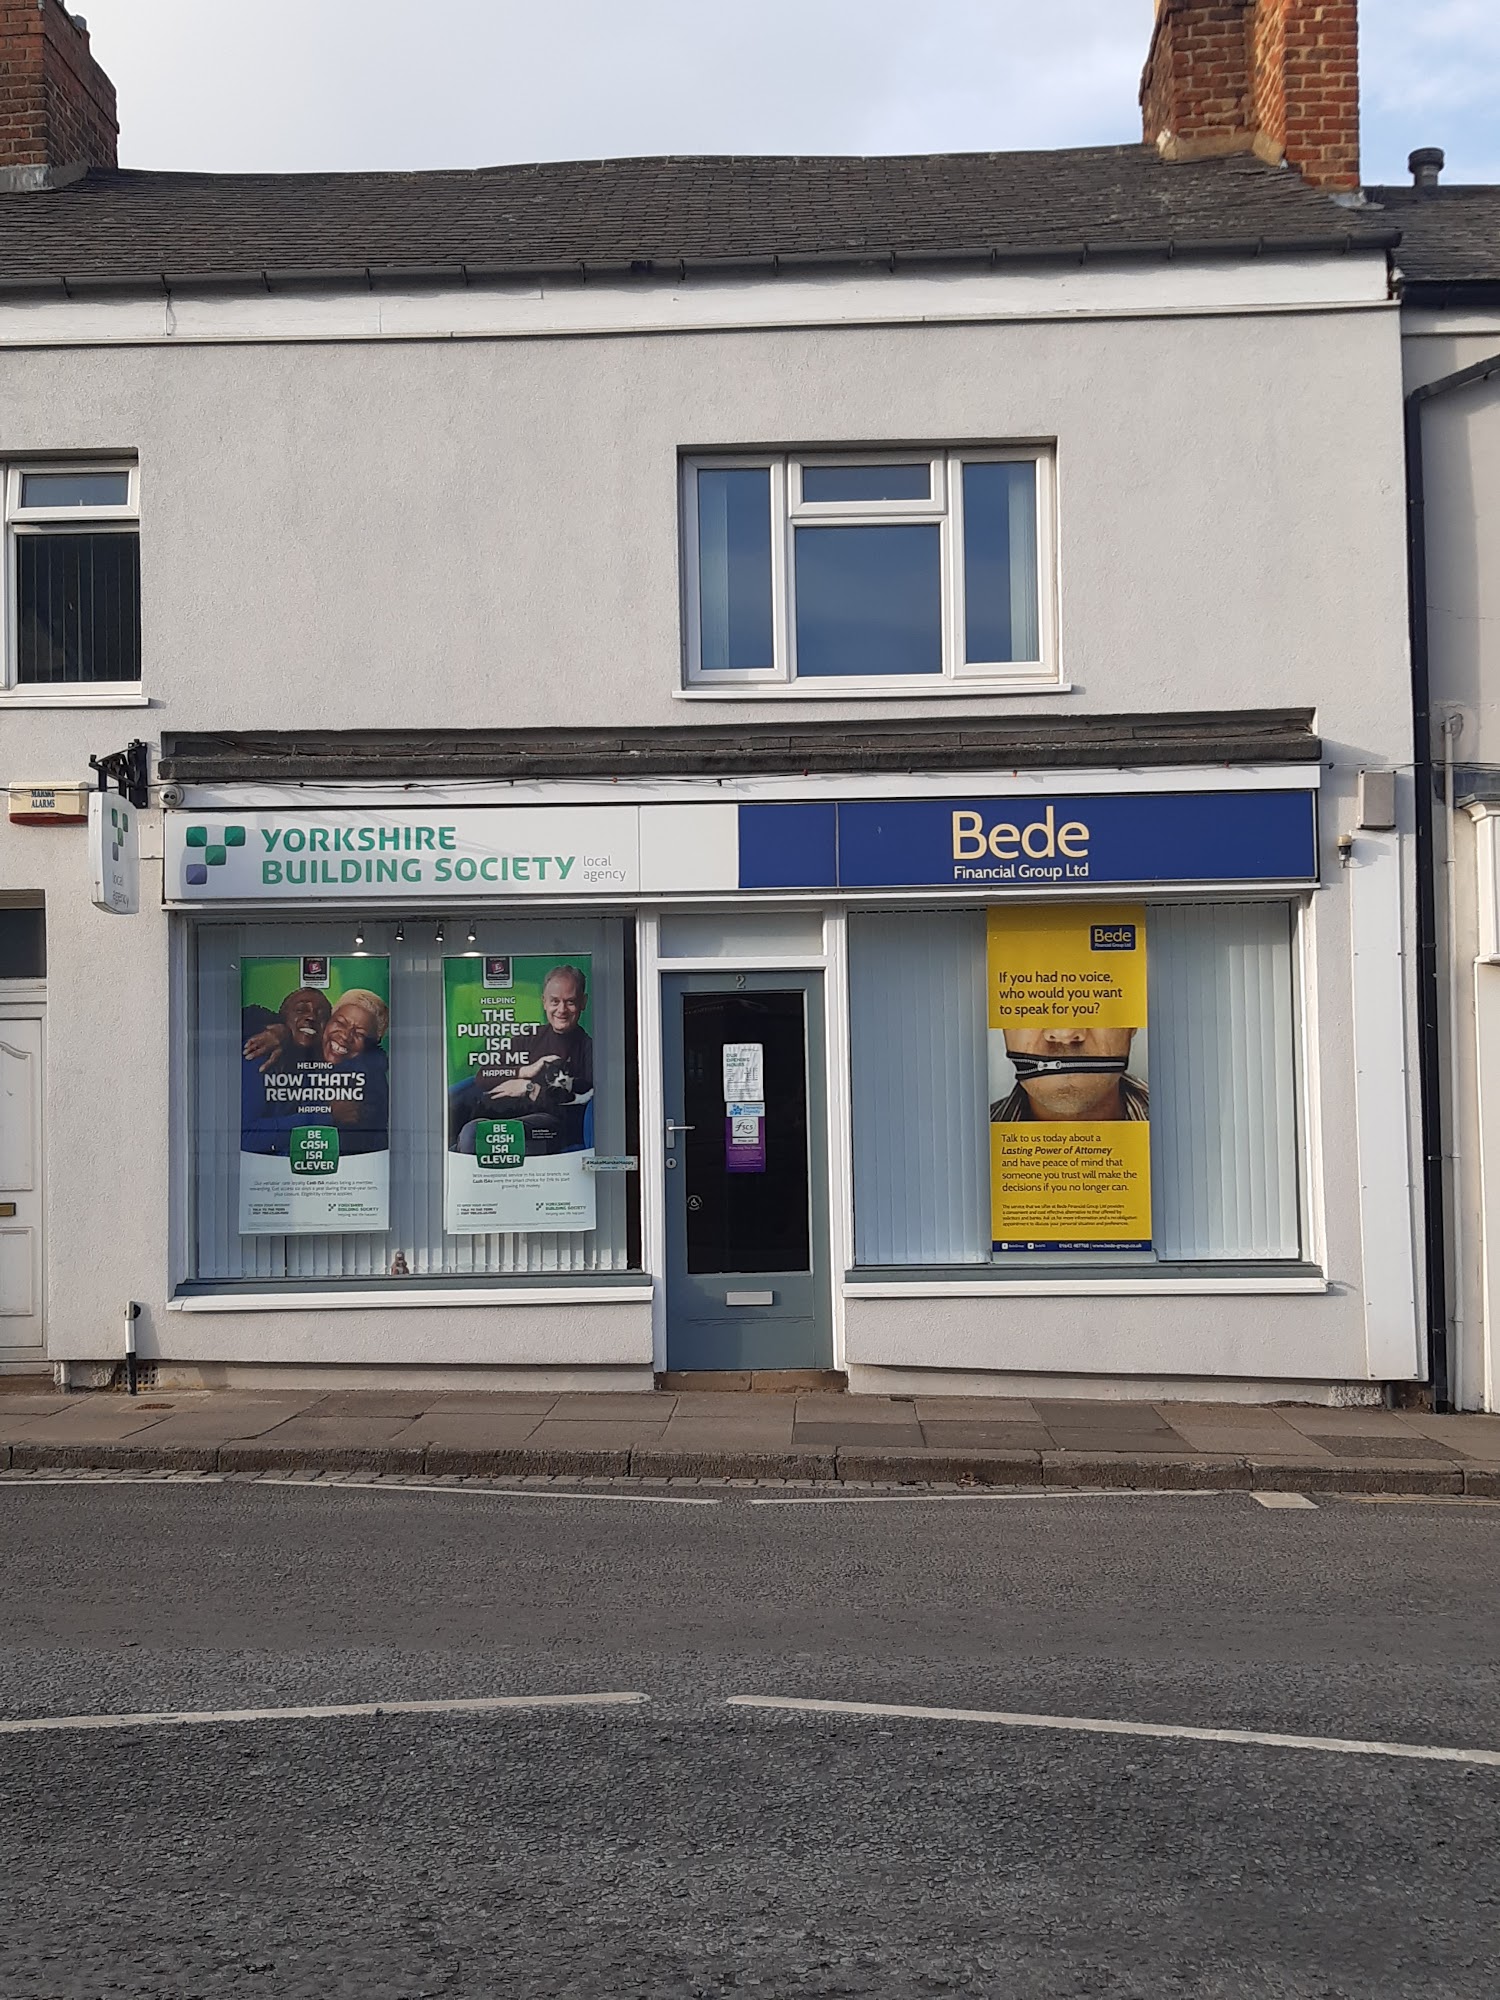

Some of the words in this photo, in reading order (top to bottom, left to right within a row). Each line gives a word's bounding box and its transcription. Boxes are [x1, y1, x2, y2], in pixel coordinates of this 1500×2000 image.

[31, 799, 55, 808] ALARMS
[952, 806, 1090, 860] Bede
[261, 826, 456, 852] YORKSHIRE
[583, 856, 612, 867] local
[262, 858, 422, 884] BUILDING
[434, 856, 576, 882] SOCIETY
[583, 868, 627, 882] agency
[954, 865, 1016, 879] Financial
[1018, 864, 1062, 880] Group
[1066, 863, 1088, 876] Ltd
[1094, 928, 1132, 942] Bede
[736, 974, 746, 990] 2
[1000, 972, 1008, 982] If
[1010, 974, 1032, 986] you
[1036, 971, 1058, 982] had
[1061, 974, 1076, 982] no
[1079, 972, 1113, 984] voice,
[1000, 987, 1024, 998] who
[1028, 987, 1064, 998] would
[1068, 990, 1090, 1001] you
[1093, 988, 1122, 998] want
[482, 1009, 514, 1022] THE
[1000, 1004, 1012, 1014] to
[1014, 1003, 1049, 1018] speak
[1052, 1002, 1068, 1014] for
[1071, 1002, 1100, 1017] you?
[458, 1023, 540, 1036] PURRFECT
[486, 1038, 512, 1050] ISA
[468, 1053, 501, 1066] FOR
[506, 1052, 530, 1064] ME
[482, 1069, 516, 1077] HAPPEN
[264, 1074, 303, 1086] NOW
[308, 1073, 366, 1086] THAT'S
[266, 1088, 364, 1100] REWARDING
[492, 1124, 507, 1133] BE
[308, 1130, 322, 1139] BE
[486, 1134, 514, 1144] CASH
[1002, 1134, 1018, 1142] Talk
[1043, 1134, 1066, 1144] today
[1069, 1134, 1094, 1142] about
[300, 1140, 328, 1150] CASH
[492, 1145, 508, 1154] ISA
[306, 1151, 322, 1160] ISA
[1002, 1147, 1032, 1156] Lasting
[1034, 1146, 1062, 1154] Power
[1064, 1146, 1074, 1154] of
[1074, 1146, 1112, 1156] Attorney
[480, 1155, 520, 1164] CLEVER
[1042, 1160, 1068, 1168] peace
[1070, 1158, 1079, 1166] of
[1081, 1158, 1104, 1166] mind
[1106, 1158, 1123, 1166] that
[294, 1161, 334, 1170] CLEVER
[1044, 1172, 1060, 1180] you
[1098, 1170, 1121, 1178] make
[1124, 1170, 1138, 1178] the
[1002, 1184, 1041, 1192] decisions
[1044, 1183, 1049, 1192] if
[1052, 1185, 1067, 1193] you
[1083, 1184, 1110, 1193] longer
